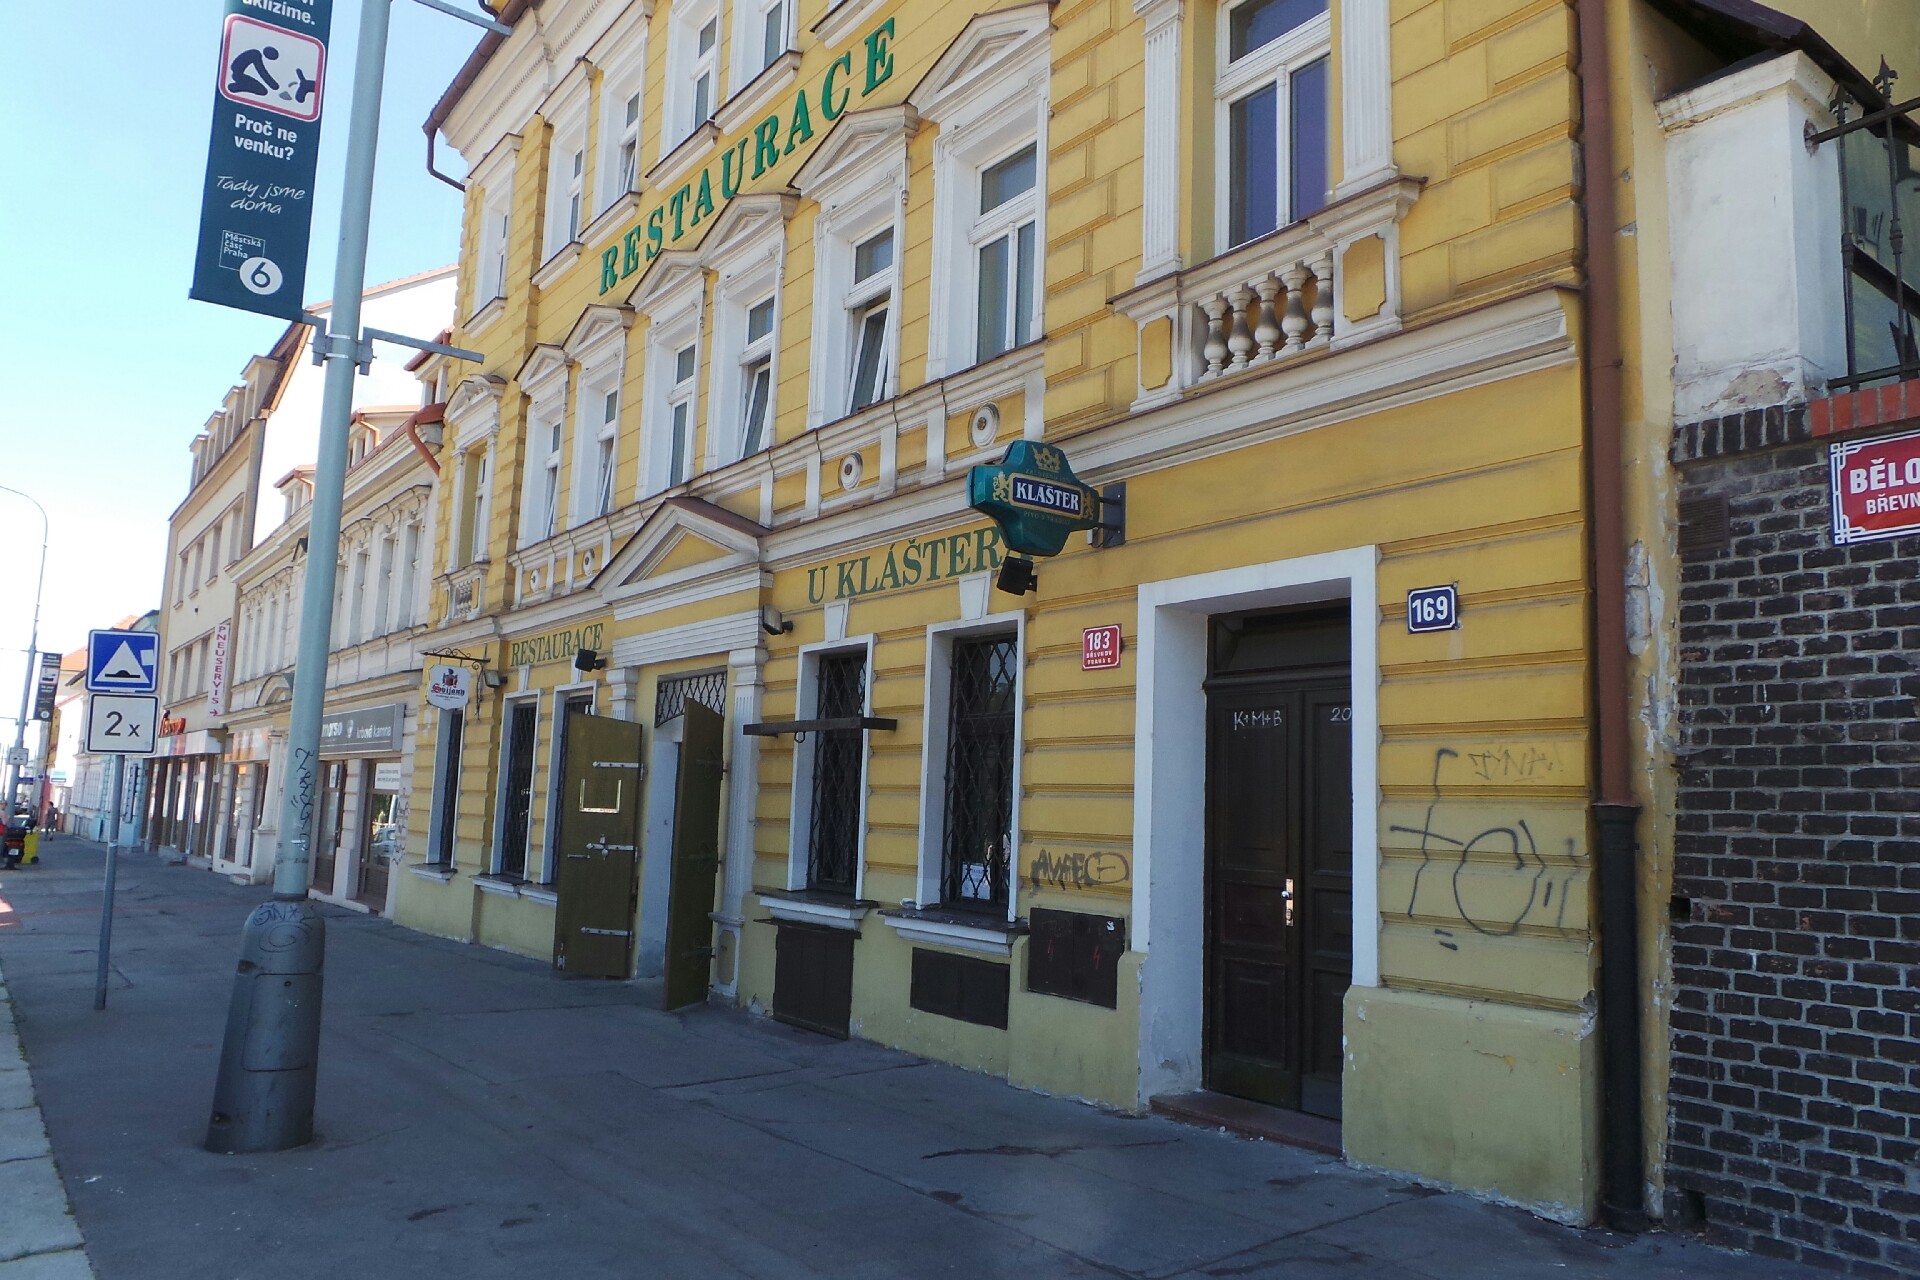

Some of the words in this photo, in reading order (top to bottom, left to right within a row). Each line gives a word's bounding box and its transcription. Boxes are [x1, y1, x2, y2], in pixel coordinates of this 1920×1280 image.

[234, 113, 274, 137] Proč
[277, 126, 298, 144] ne
[234, 135, 295, 161] venku?
[598, 16, 896, 296] RESTAURACE
[215, 175, 260, 198] Tady
[259, 182, 306, 201] jsme
[230, 197, 282, 215] doma
[223, 246, 248, 259] Praha
[250, 261, 271, 288] 6
[1016, 483, 1080, 511] KLÁŠTER
[807, 565, 829, 605] U
[835, 527, 1033, 600] KLÁŠTER
[1412, 595, 1448, 623] 169
[511, 622, 605, 667] RESTAURACE
[1087, 630, 1111, 651] 183
[211, 625, 227, 705] PNEUSERVIS
[104, 711, 124, 737] 2
